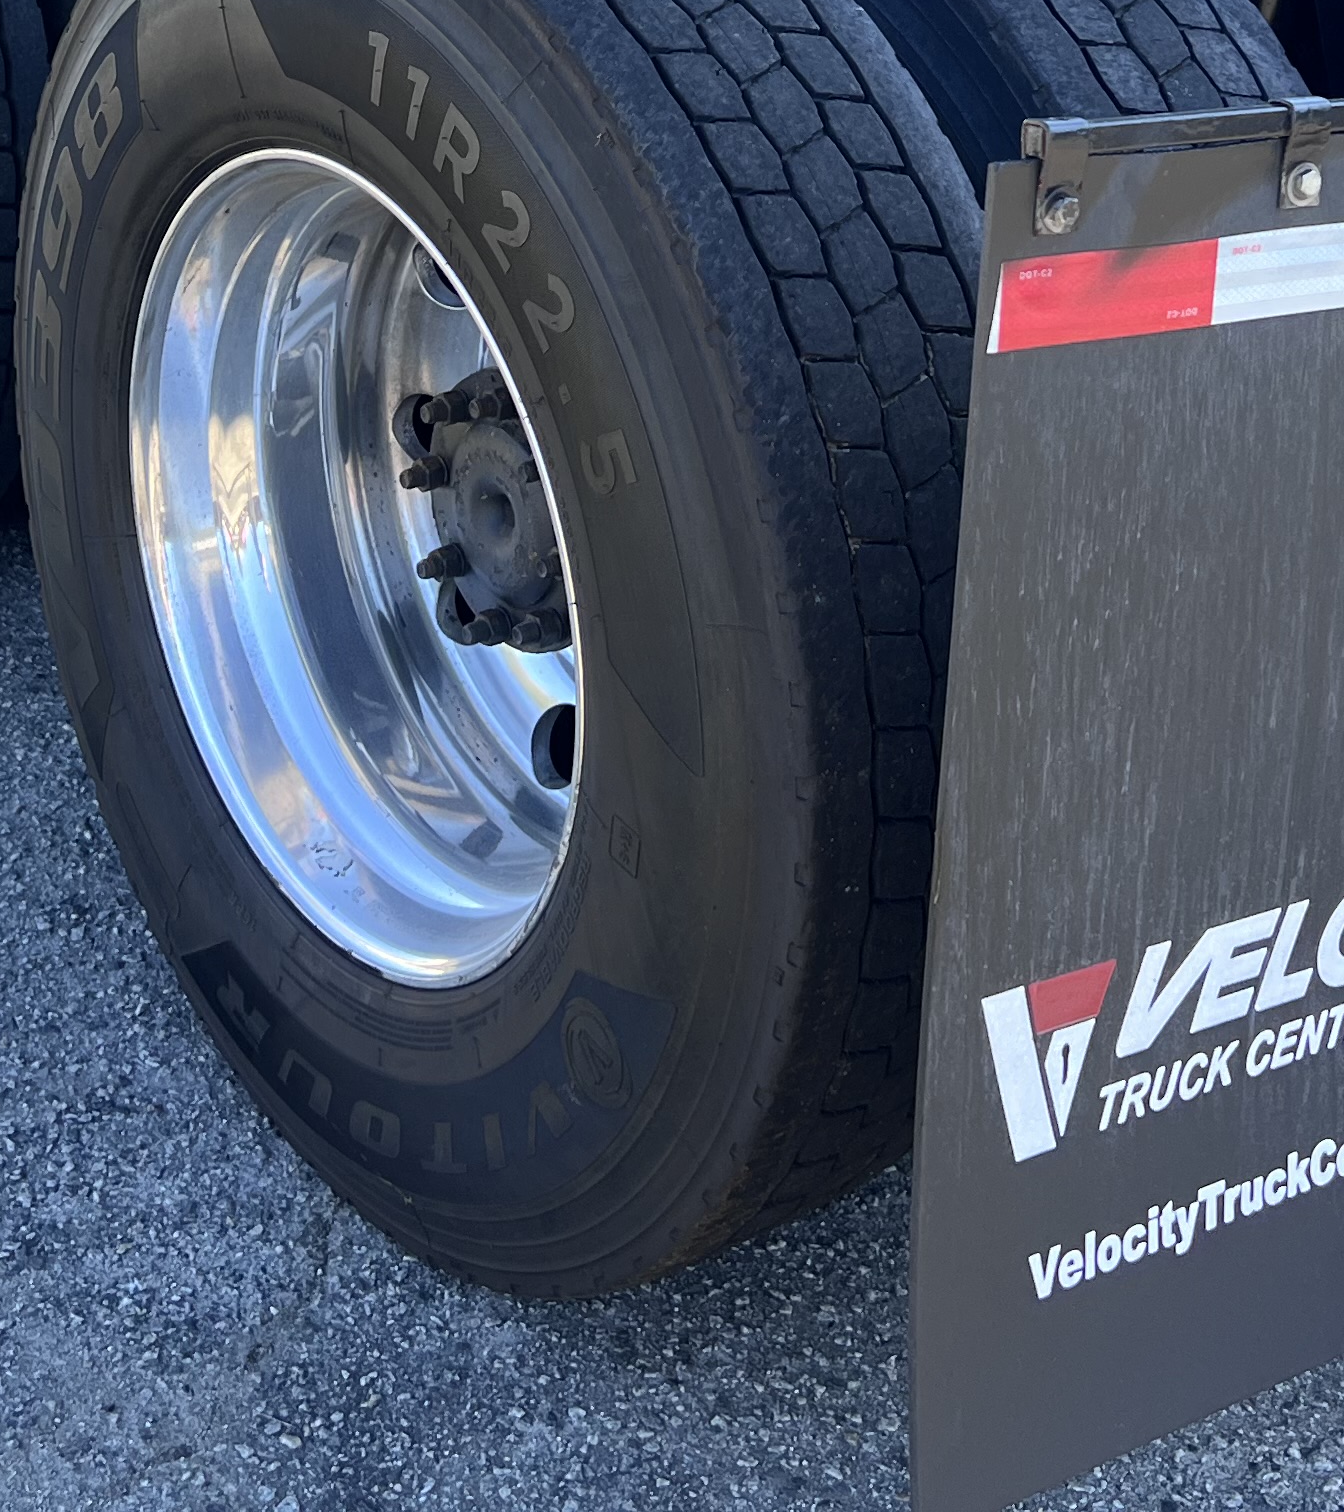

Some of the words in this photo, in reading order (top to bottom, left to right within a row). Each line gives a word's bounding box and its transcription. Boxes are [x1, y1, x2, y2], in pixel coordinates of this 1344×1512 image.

[367, 30, 640, 496] 11R22.5
[1018, 268, 1054, 281] DOT-C2
[1166, 307, 1199, 319] DOT-C2
[1097, 1038, 1240, 1132] TRUCK
